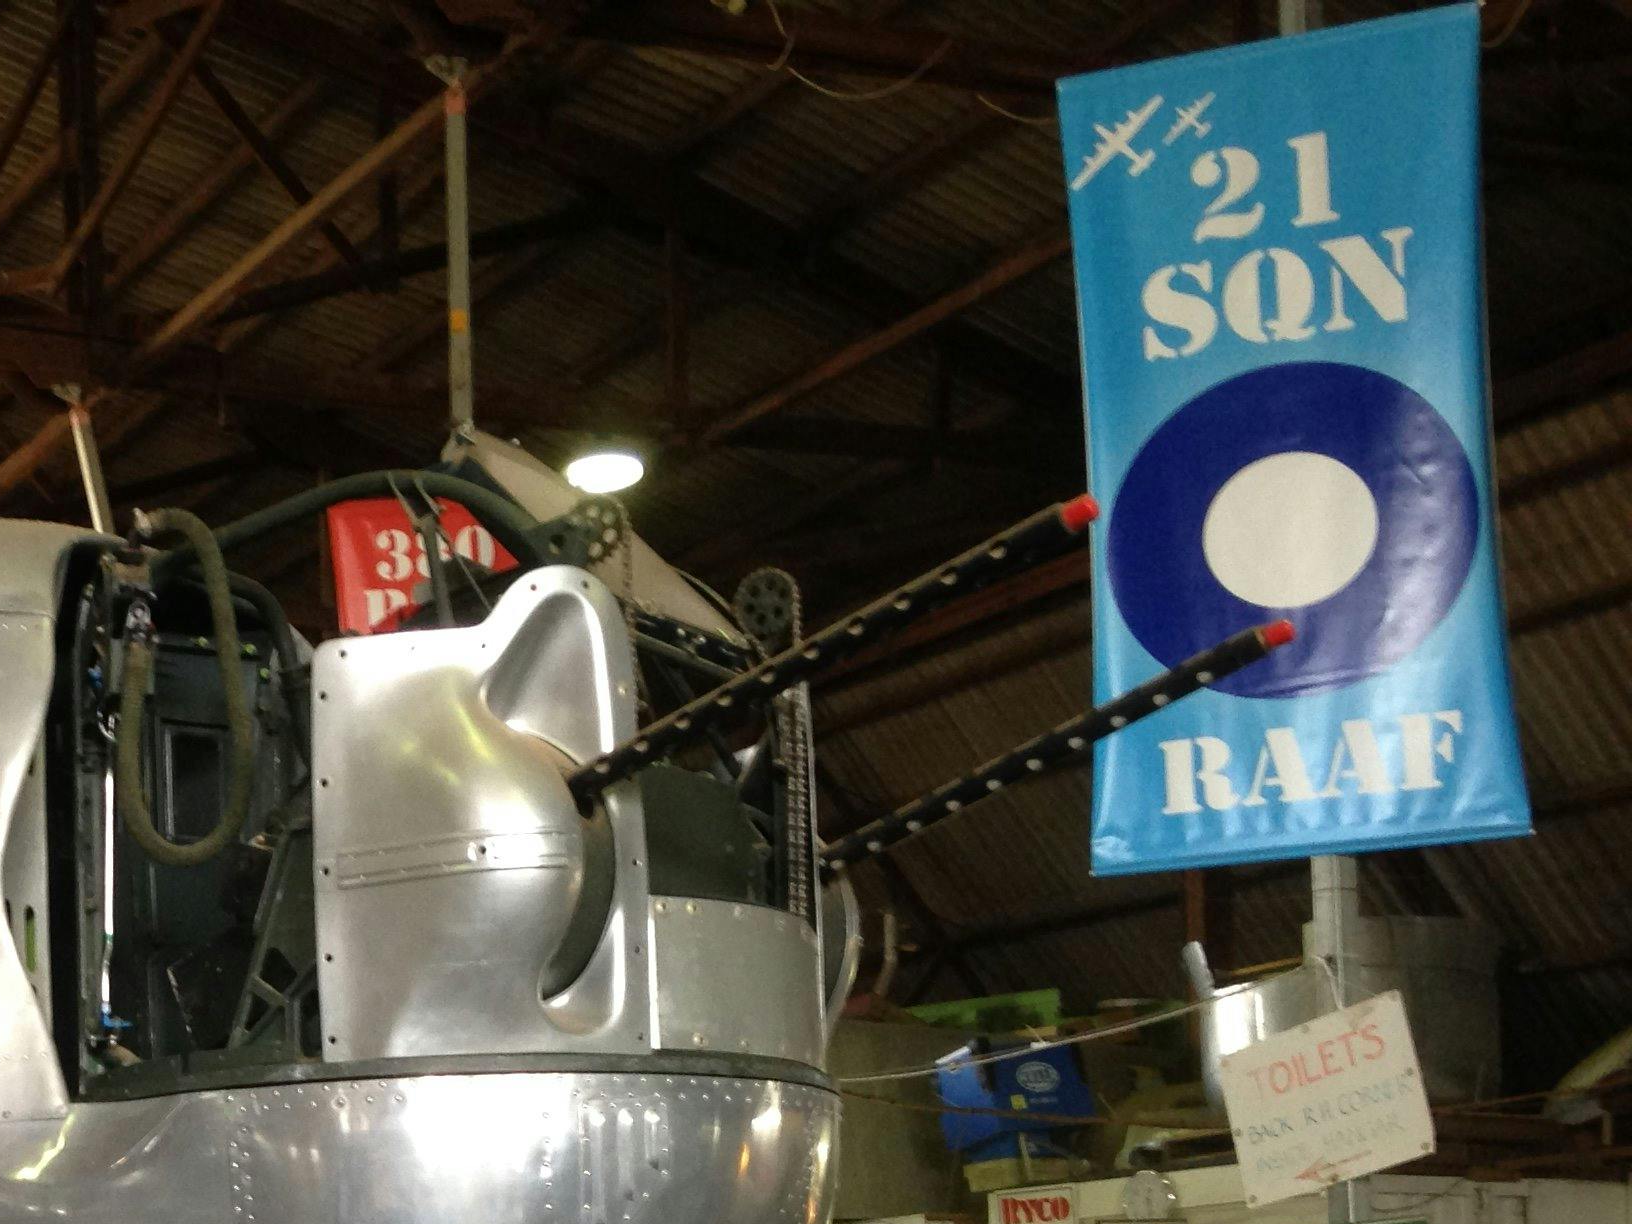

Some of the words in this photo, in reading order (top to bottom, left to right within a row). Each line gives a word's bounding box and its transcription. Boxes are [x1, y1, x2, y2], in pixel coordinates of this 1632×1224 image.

[1189, 130, 1340, 244] 21
[1141, 225, 1415, 361] SQN
[1159, 710, 1465, 818] RAAF
[1247, 1022, 1386, 1101] TOILETS
